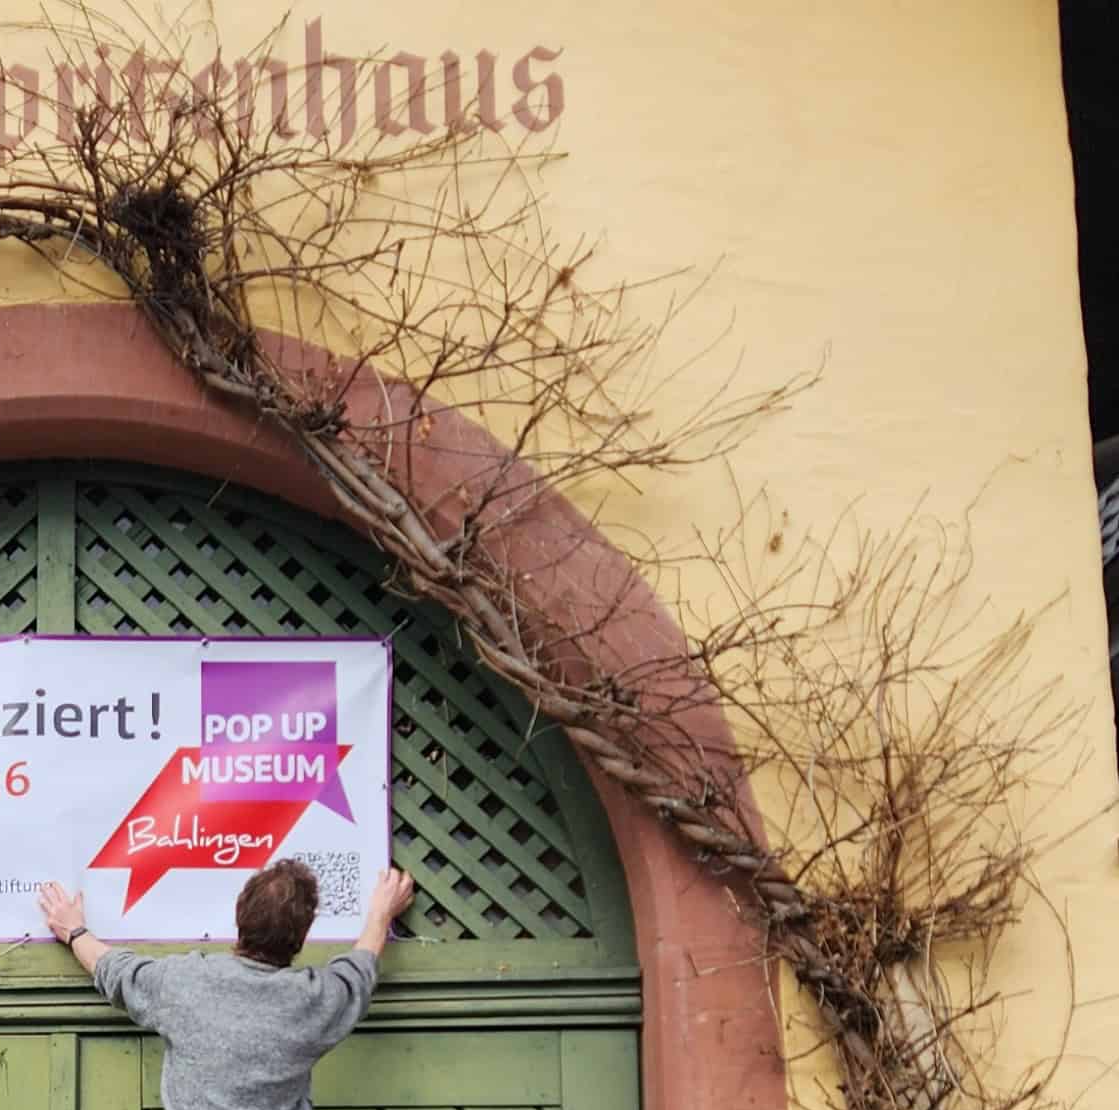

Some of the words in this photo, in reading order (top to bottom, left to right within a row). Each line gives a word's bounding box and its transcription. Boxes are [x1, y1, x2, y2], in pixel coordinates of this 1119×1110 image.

[204, 713, 273, 743] POP
[281, 711, 327, 741] UP
[182, 754, 325, 784] MUSEUM
[127, 815, 274, 865] Bahlingen
